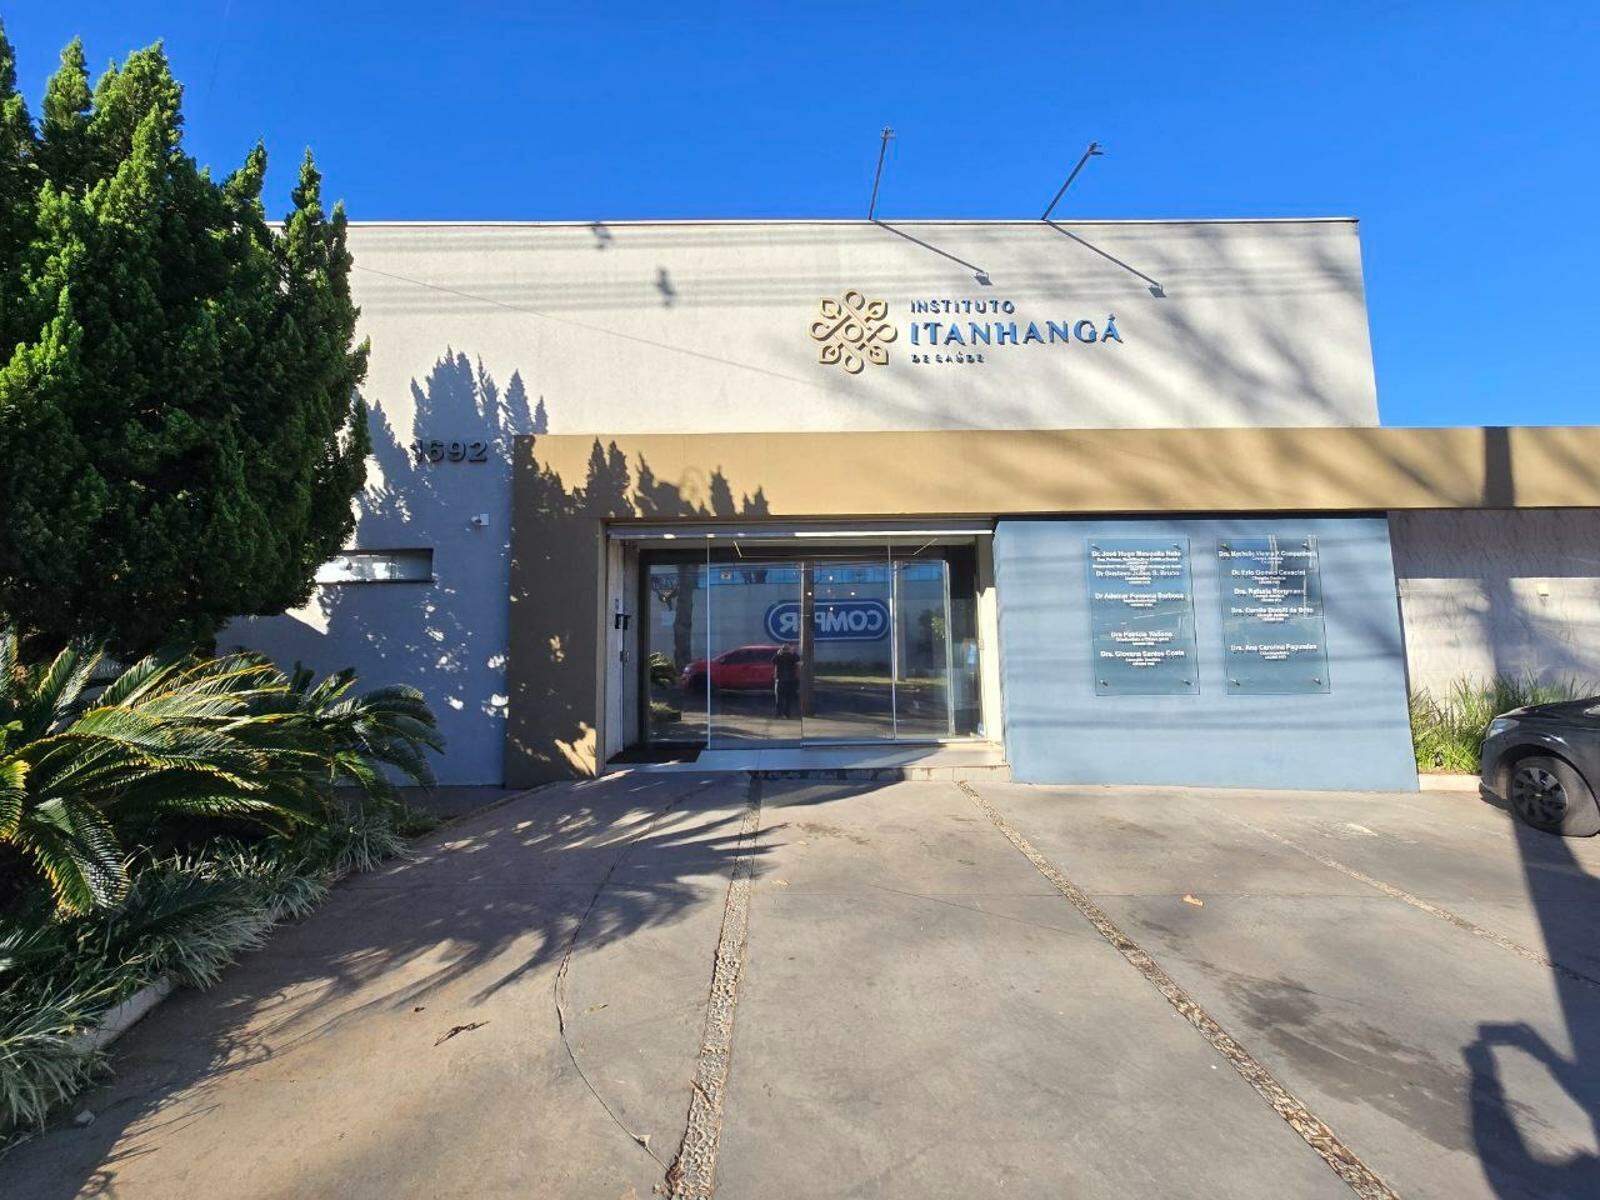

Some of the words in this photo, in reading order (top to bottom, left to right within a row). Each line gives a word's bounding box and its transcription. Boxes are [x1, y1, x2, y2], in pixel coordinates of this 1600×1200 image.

[911, 299, 1015, 314] INSTITUTO
[911, 313, 1123, 345] ITANHANGÁ
[410, 439, 487, 462] 1692
